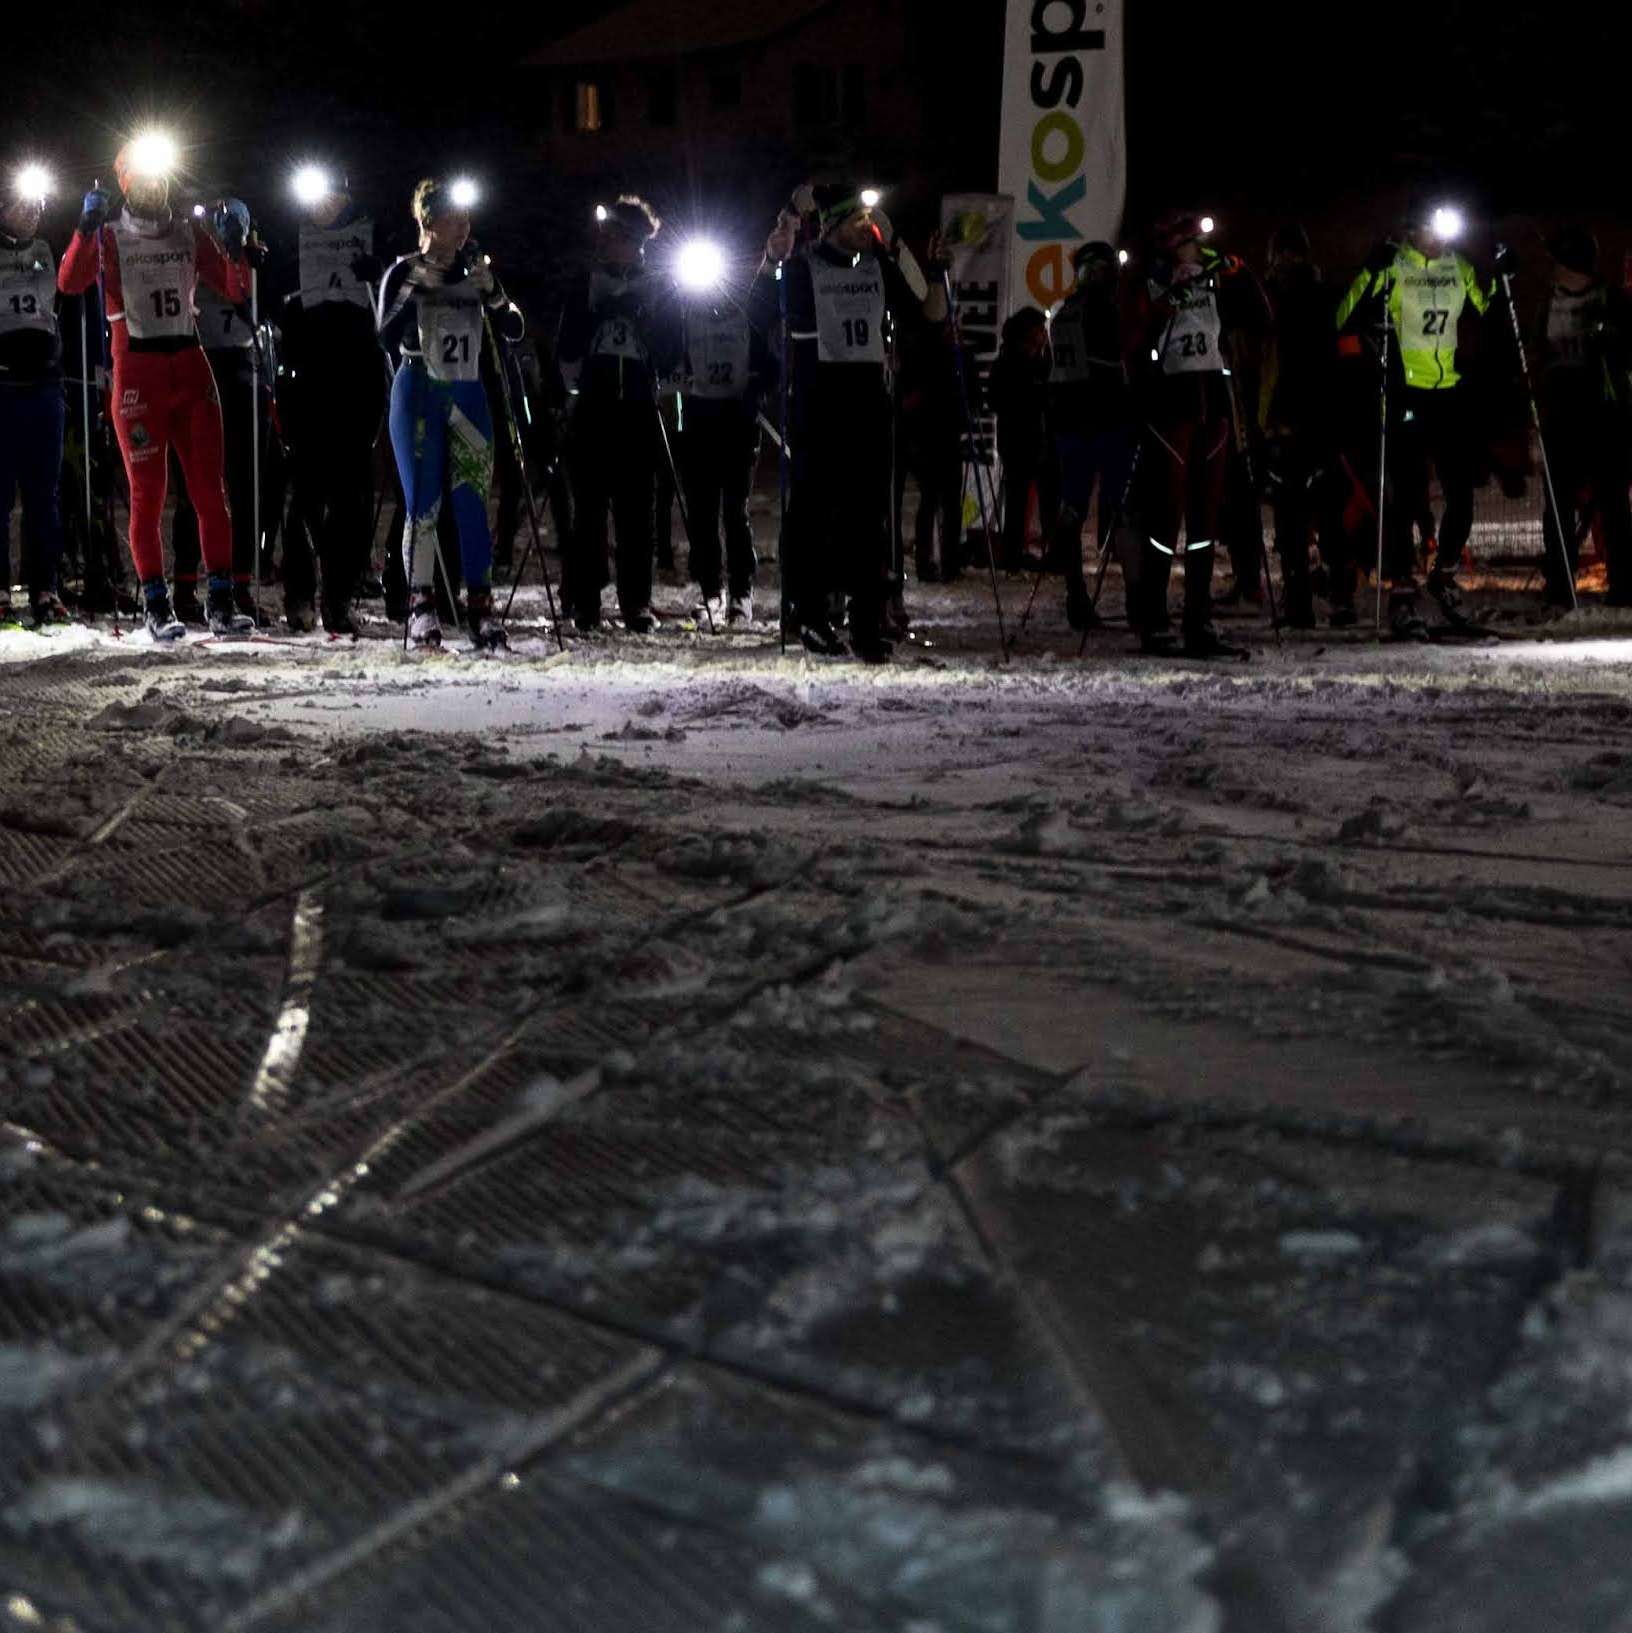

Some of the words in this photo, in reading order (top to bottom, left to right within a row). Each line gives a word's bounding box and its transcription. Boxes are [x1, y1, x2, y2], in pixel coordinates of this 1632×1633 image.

[150, 288, 181, 318] 15
[221, 309, 233, 334] 7
[1423, 309, 1449, 336] 27
[443, 334, 469, 363] 21
